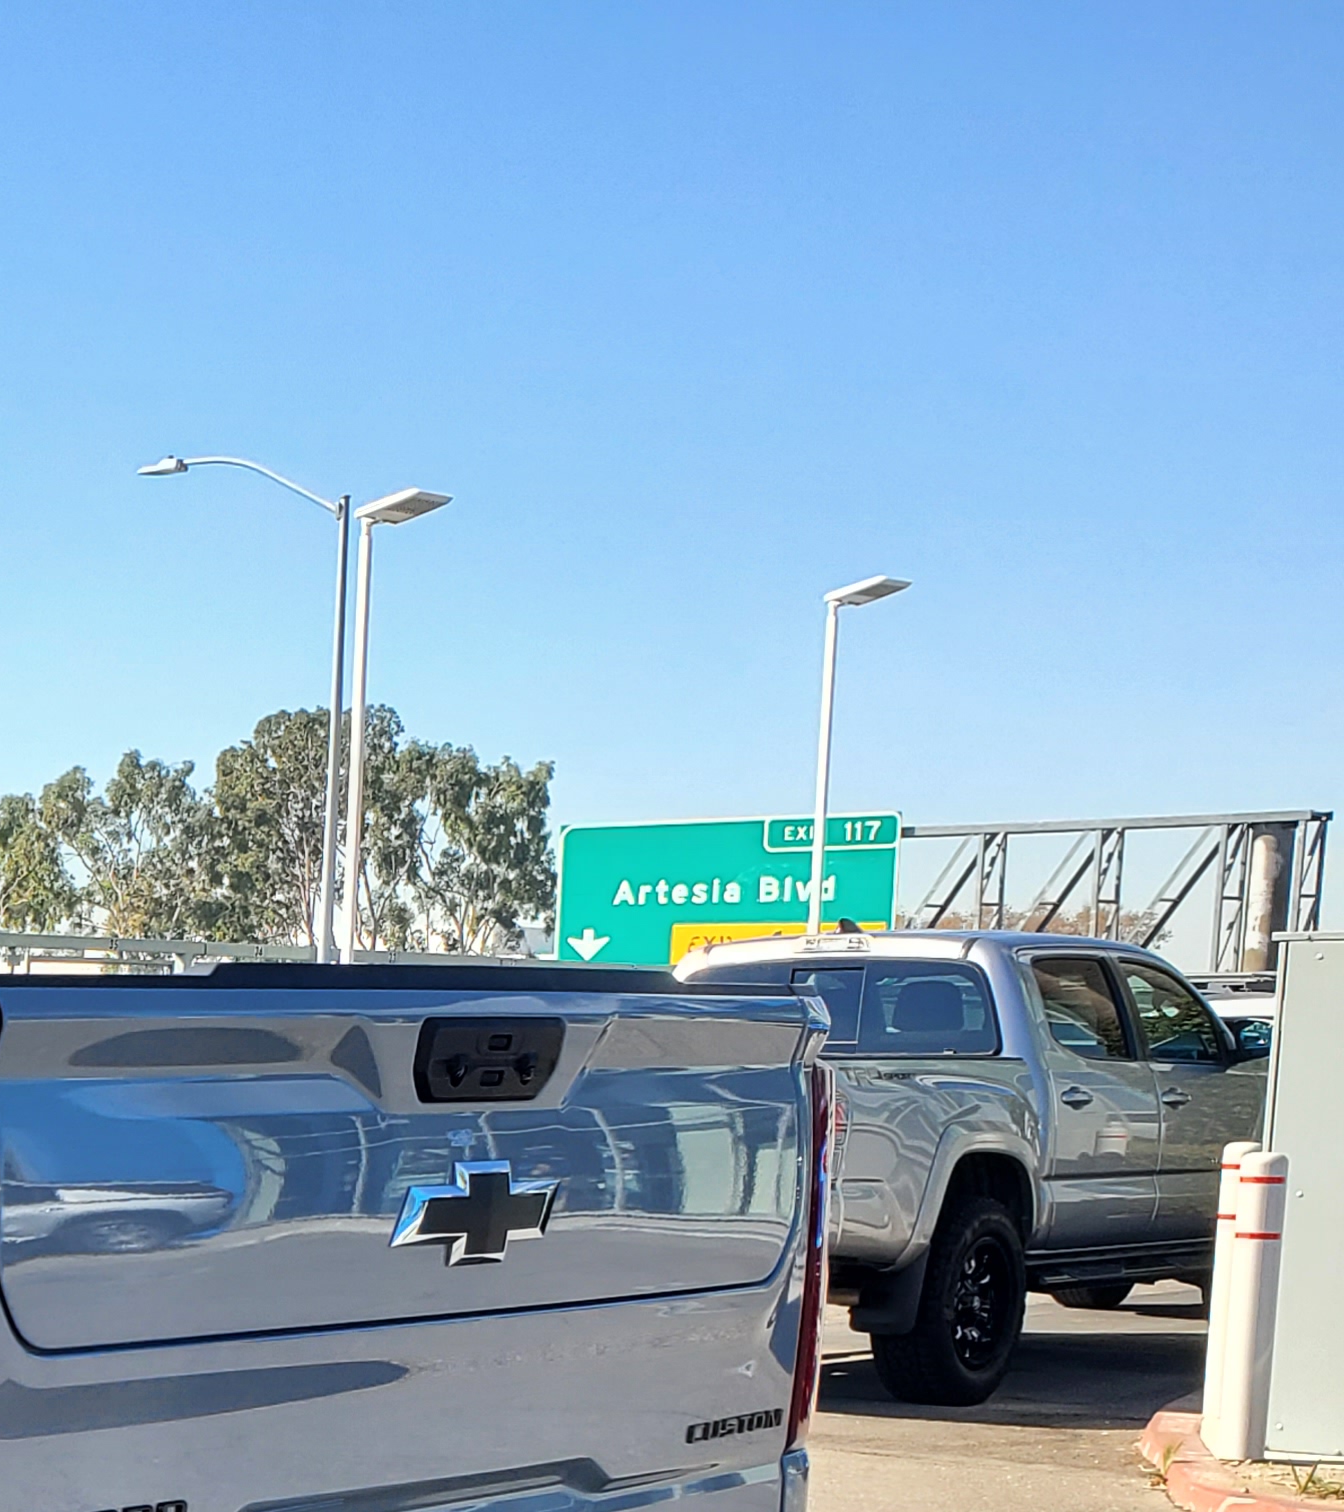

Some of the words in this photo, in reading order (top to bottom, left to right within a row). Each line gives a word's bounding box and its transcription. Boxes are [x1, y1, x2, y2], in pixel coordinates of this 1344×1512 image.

[783, 825, 814, 842] EXI
[844, 820, 882, 842] 117
[612, 878, 741, 906] Artesia
[685, 1408, 784, 1444] CUSTOM
